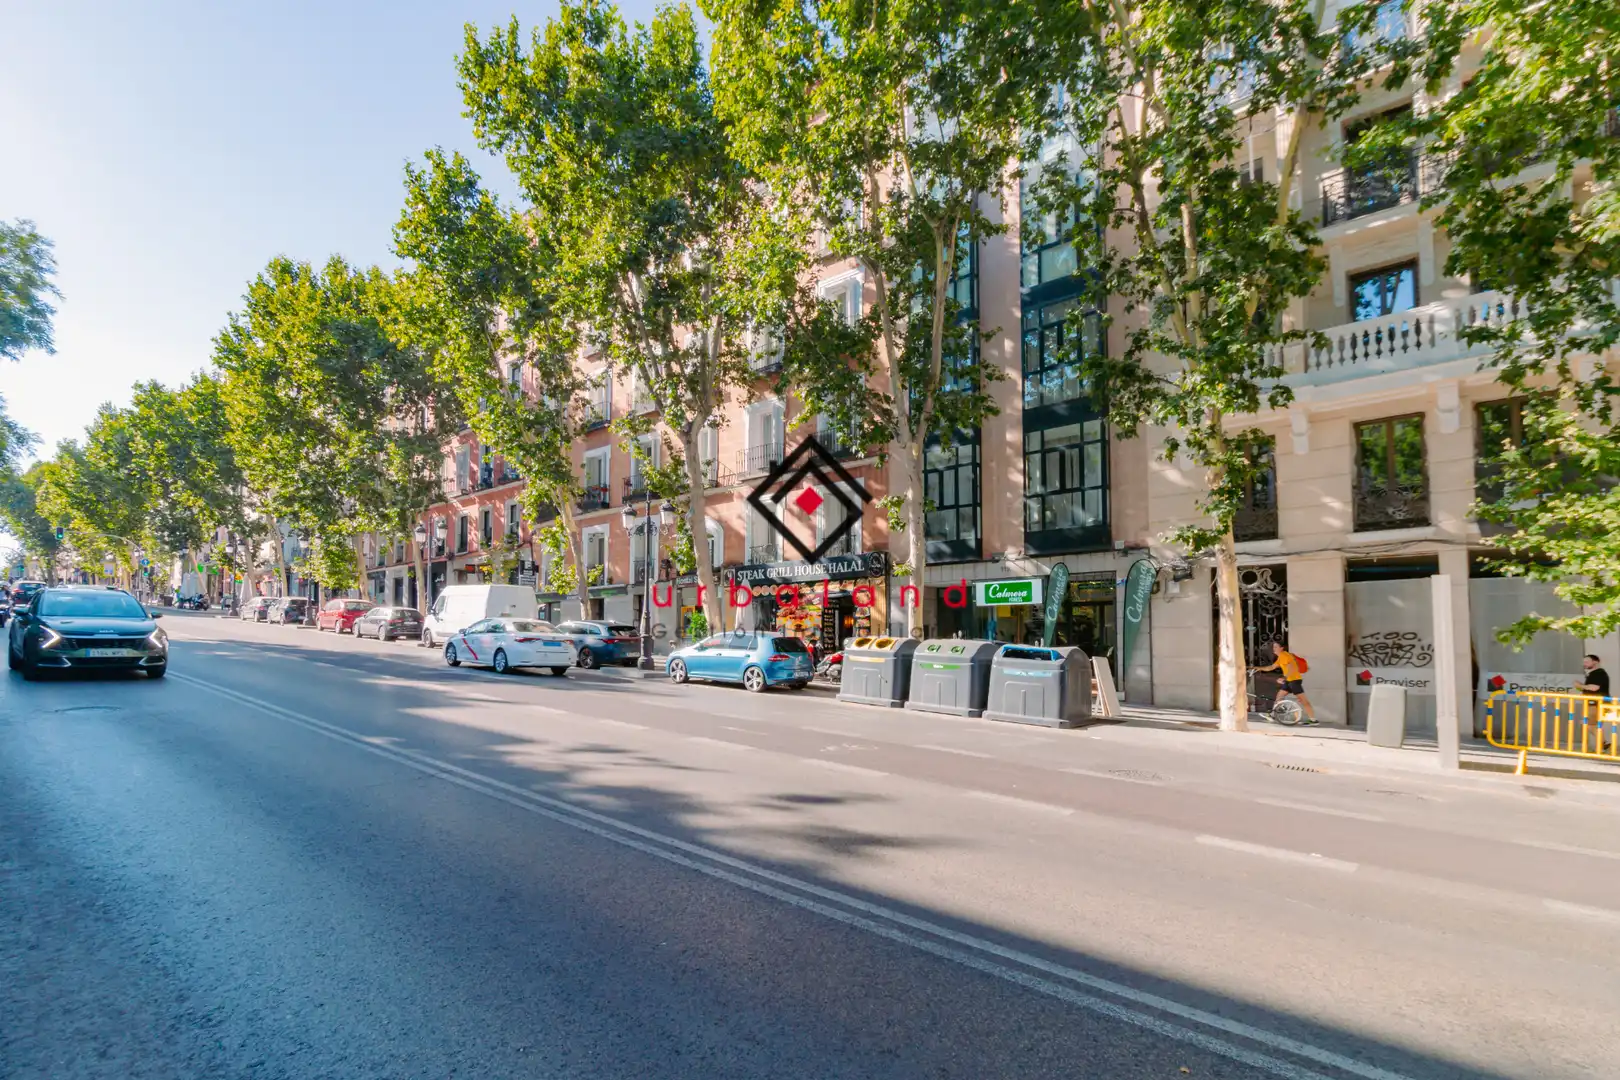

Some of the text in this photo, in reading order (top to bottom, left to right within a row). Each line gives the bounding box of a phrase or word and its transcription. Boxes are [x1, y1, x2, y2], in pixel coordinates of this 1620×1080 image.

[737, 568, 765, 581] STEAK
[767, 566, 792, 578] GRILL
[794, 563, 827, 576] HOUSE
[828, 560, 864, 573] HALAL
